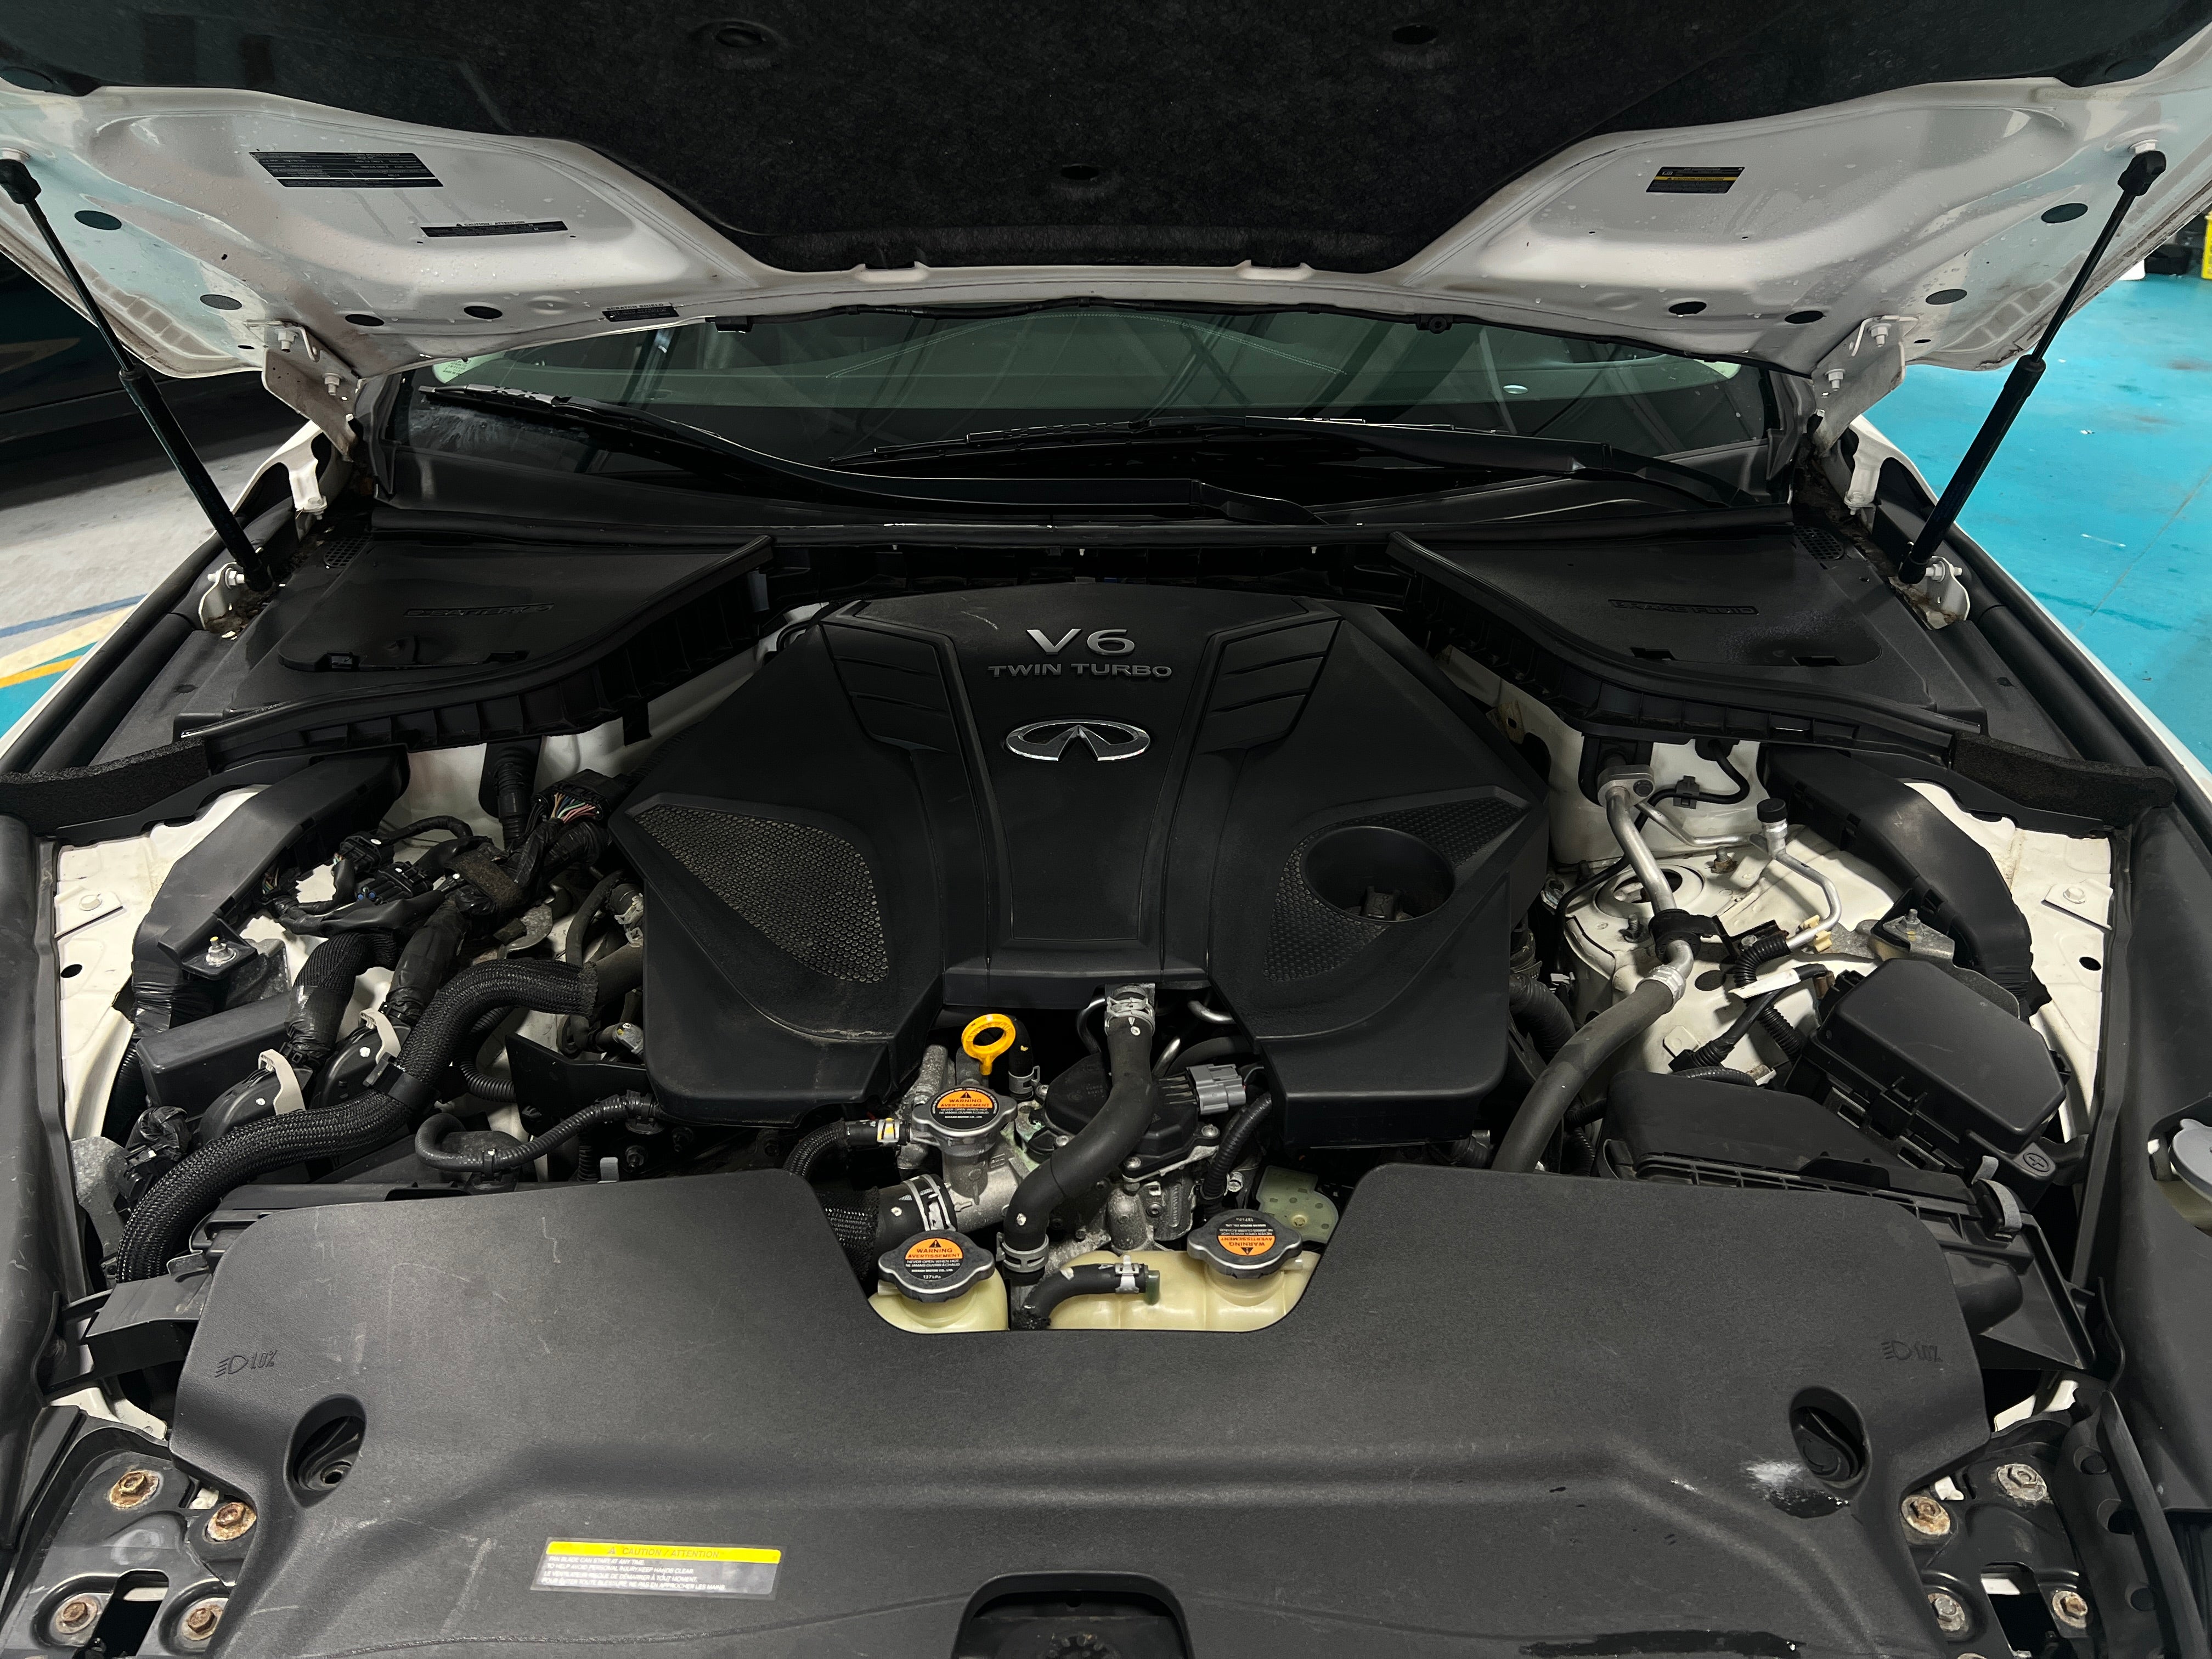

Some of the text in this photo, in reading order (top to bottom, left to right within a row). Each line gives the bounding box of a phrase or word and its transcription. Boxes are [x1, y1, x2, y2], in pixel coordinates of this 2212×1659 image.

[1691, 606, 1757, 614] FLUID
[1027, 628, 1136, 657] V6
[988, 663, 1172, 679] TWIN TURBO
[251, 1350, 278, 1369] 10%
[622, 1547, 662, 1556] CAUTION
[670, 1550, 720, 1558] ATTENTION
